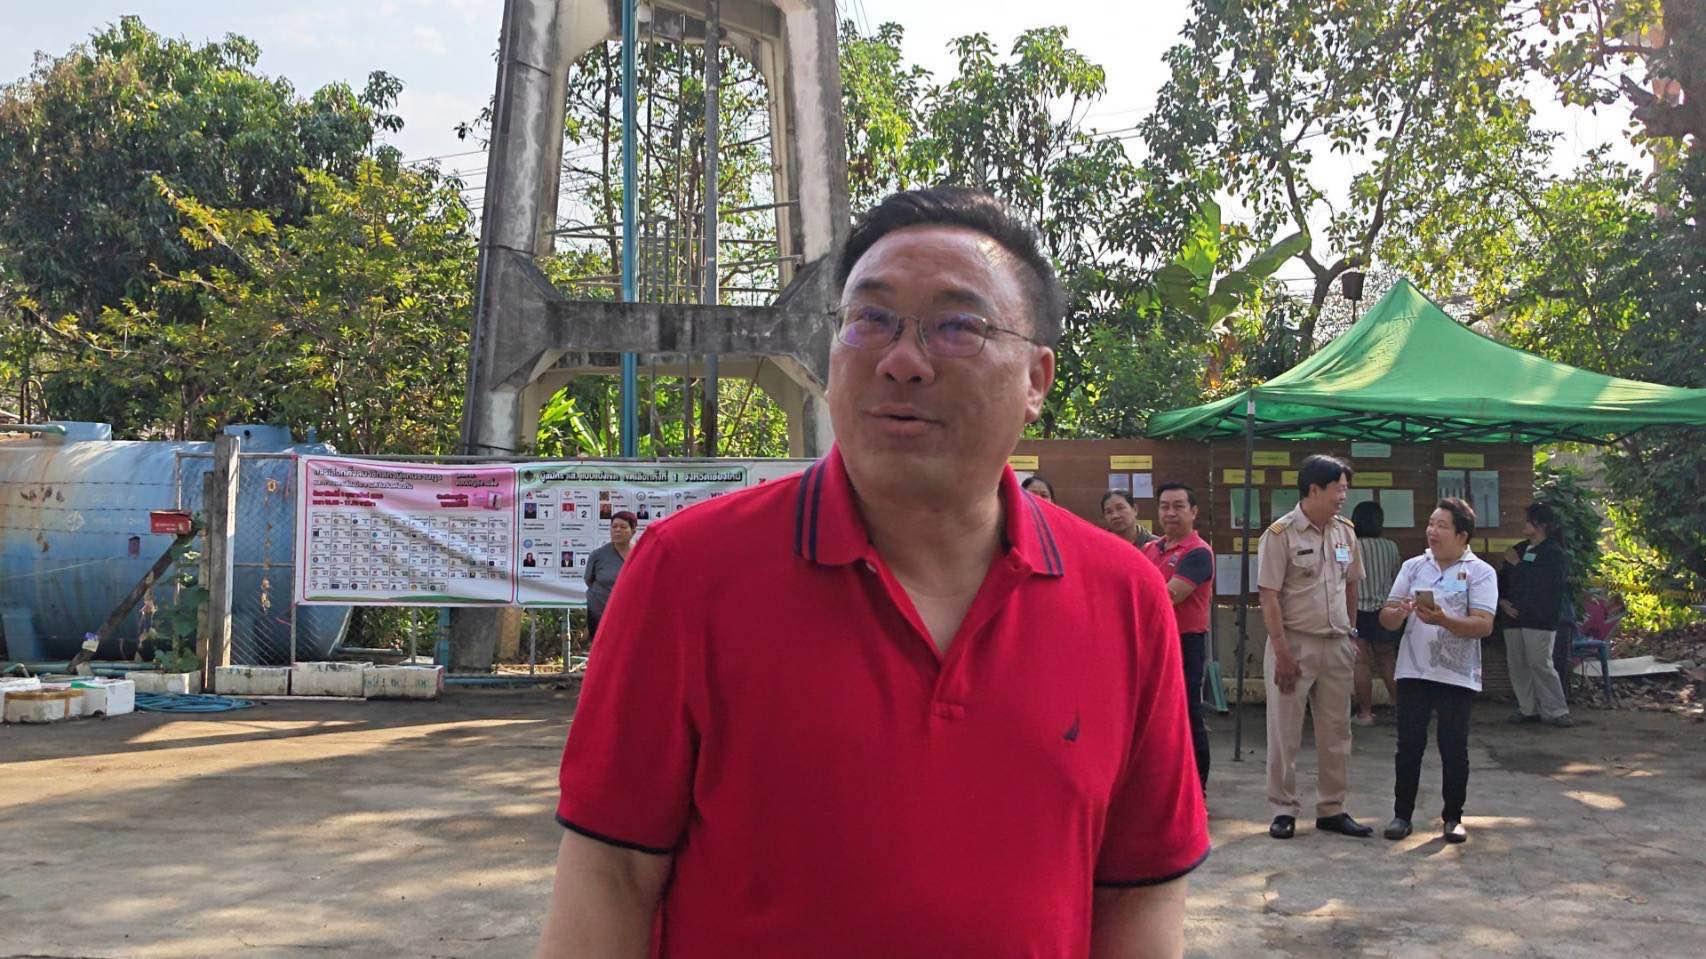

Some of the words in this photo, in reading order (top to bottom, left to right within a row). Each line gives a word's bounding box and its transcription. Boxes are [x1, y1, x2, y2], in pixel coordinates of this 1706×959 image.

[672, 473, 679, 483] 1
[684, 470, 743, 483] จังหวัดเชียงใหม่
[543, 510, 549, 518] 1
[581, 510, 587, 518] 2
[543, 558, 549, 566] 7
